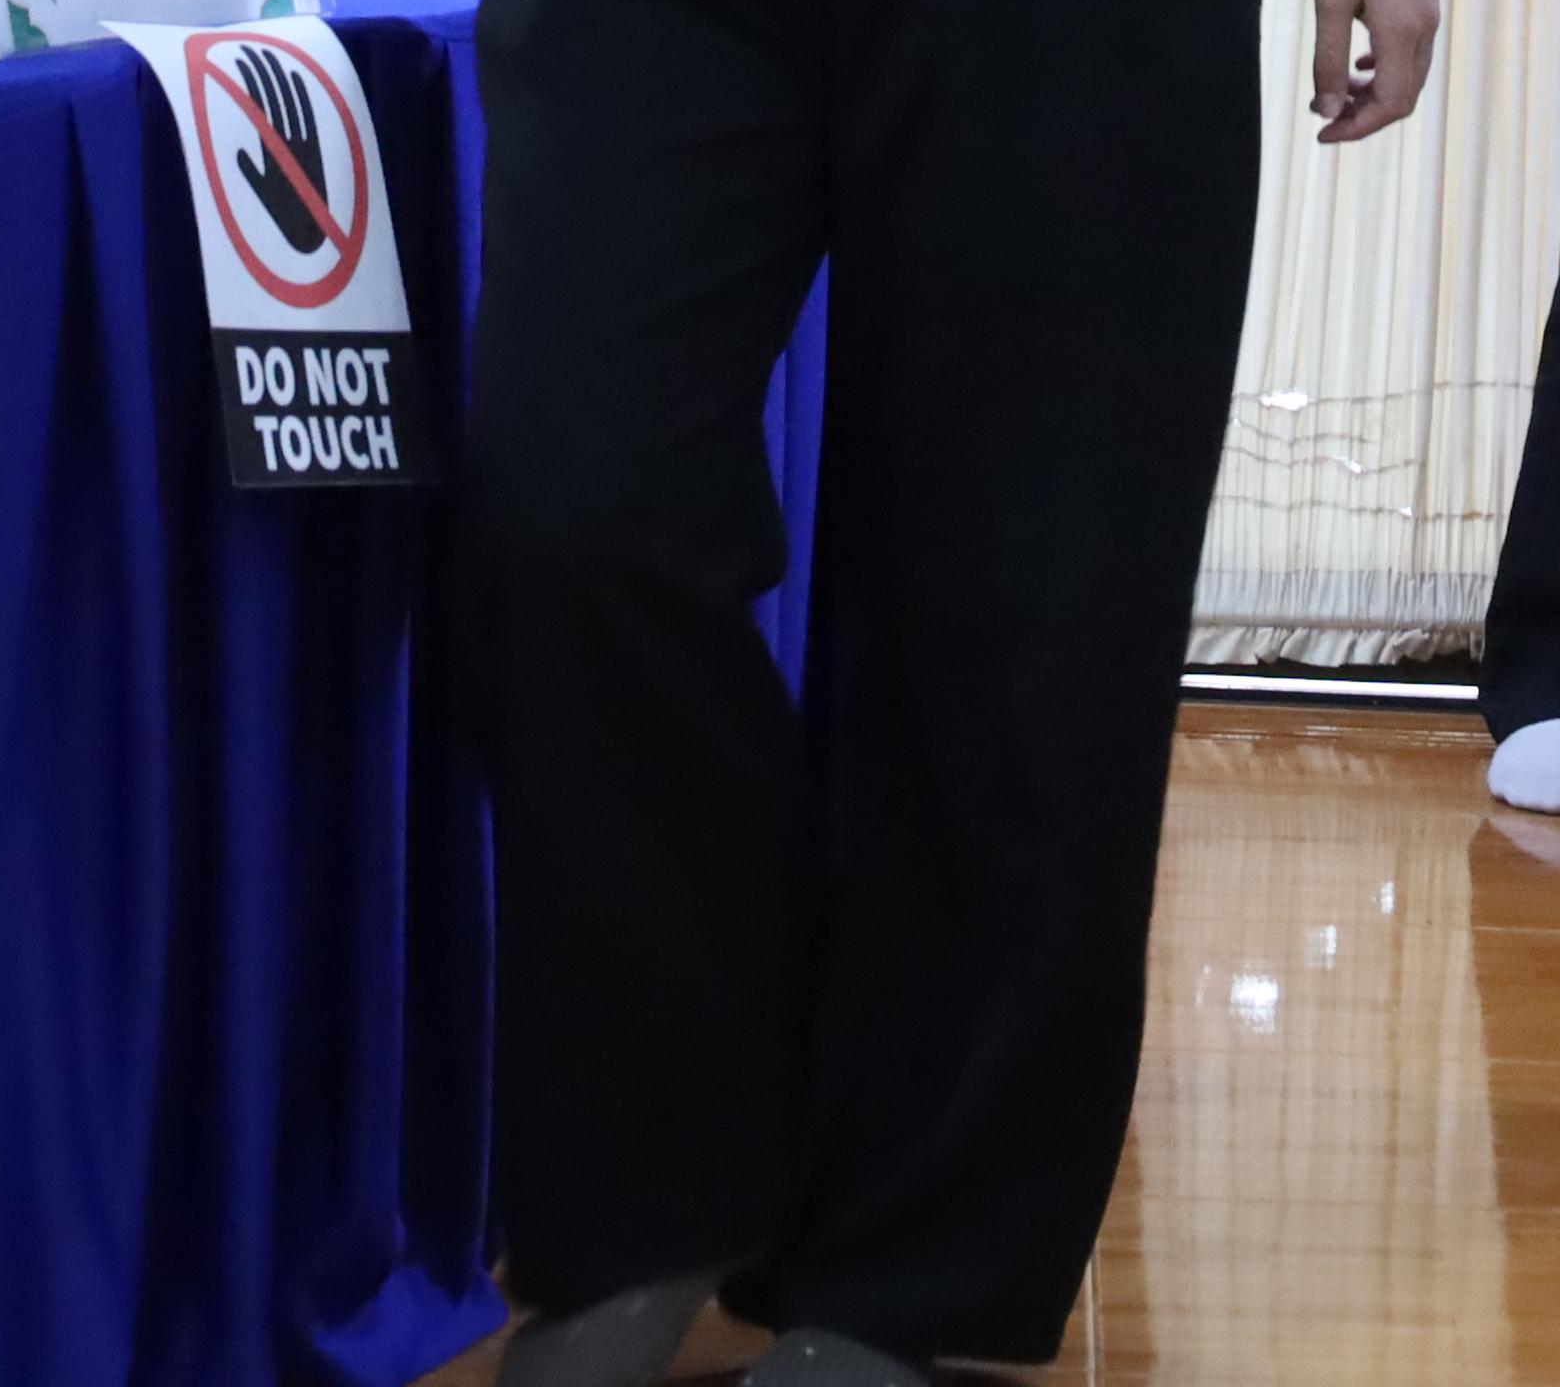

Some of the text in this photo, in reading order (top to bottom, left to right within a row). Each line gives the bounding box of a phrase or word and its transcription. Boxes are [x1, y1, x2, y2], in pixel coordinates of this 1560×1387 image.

[236, 346, 391, 406] DO NOT
[254, 415, 399, 471] TOUCH
